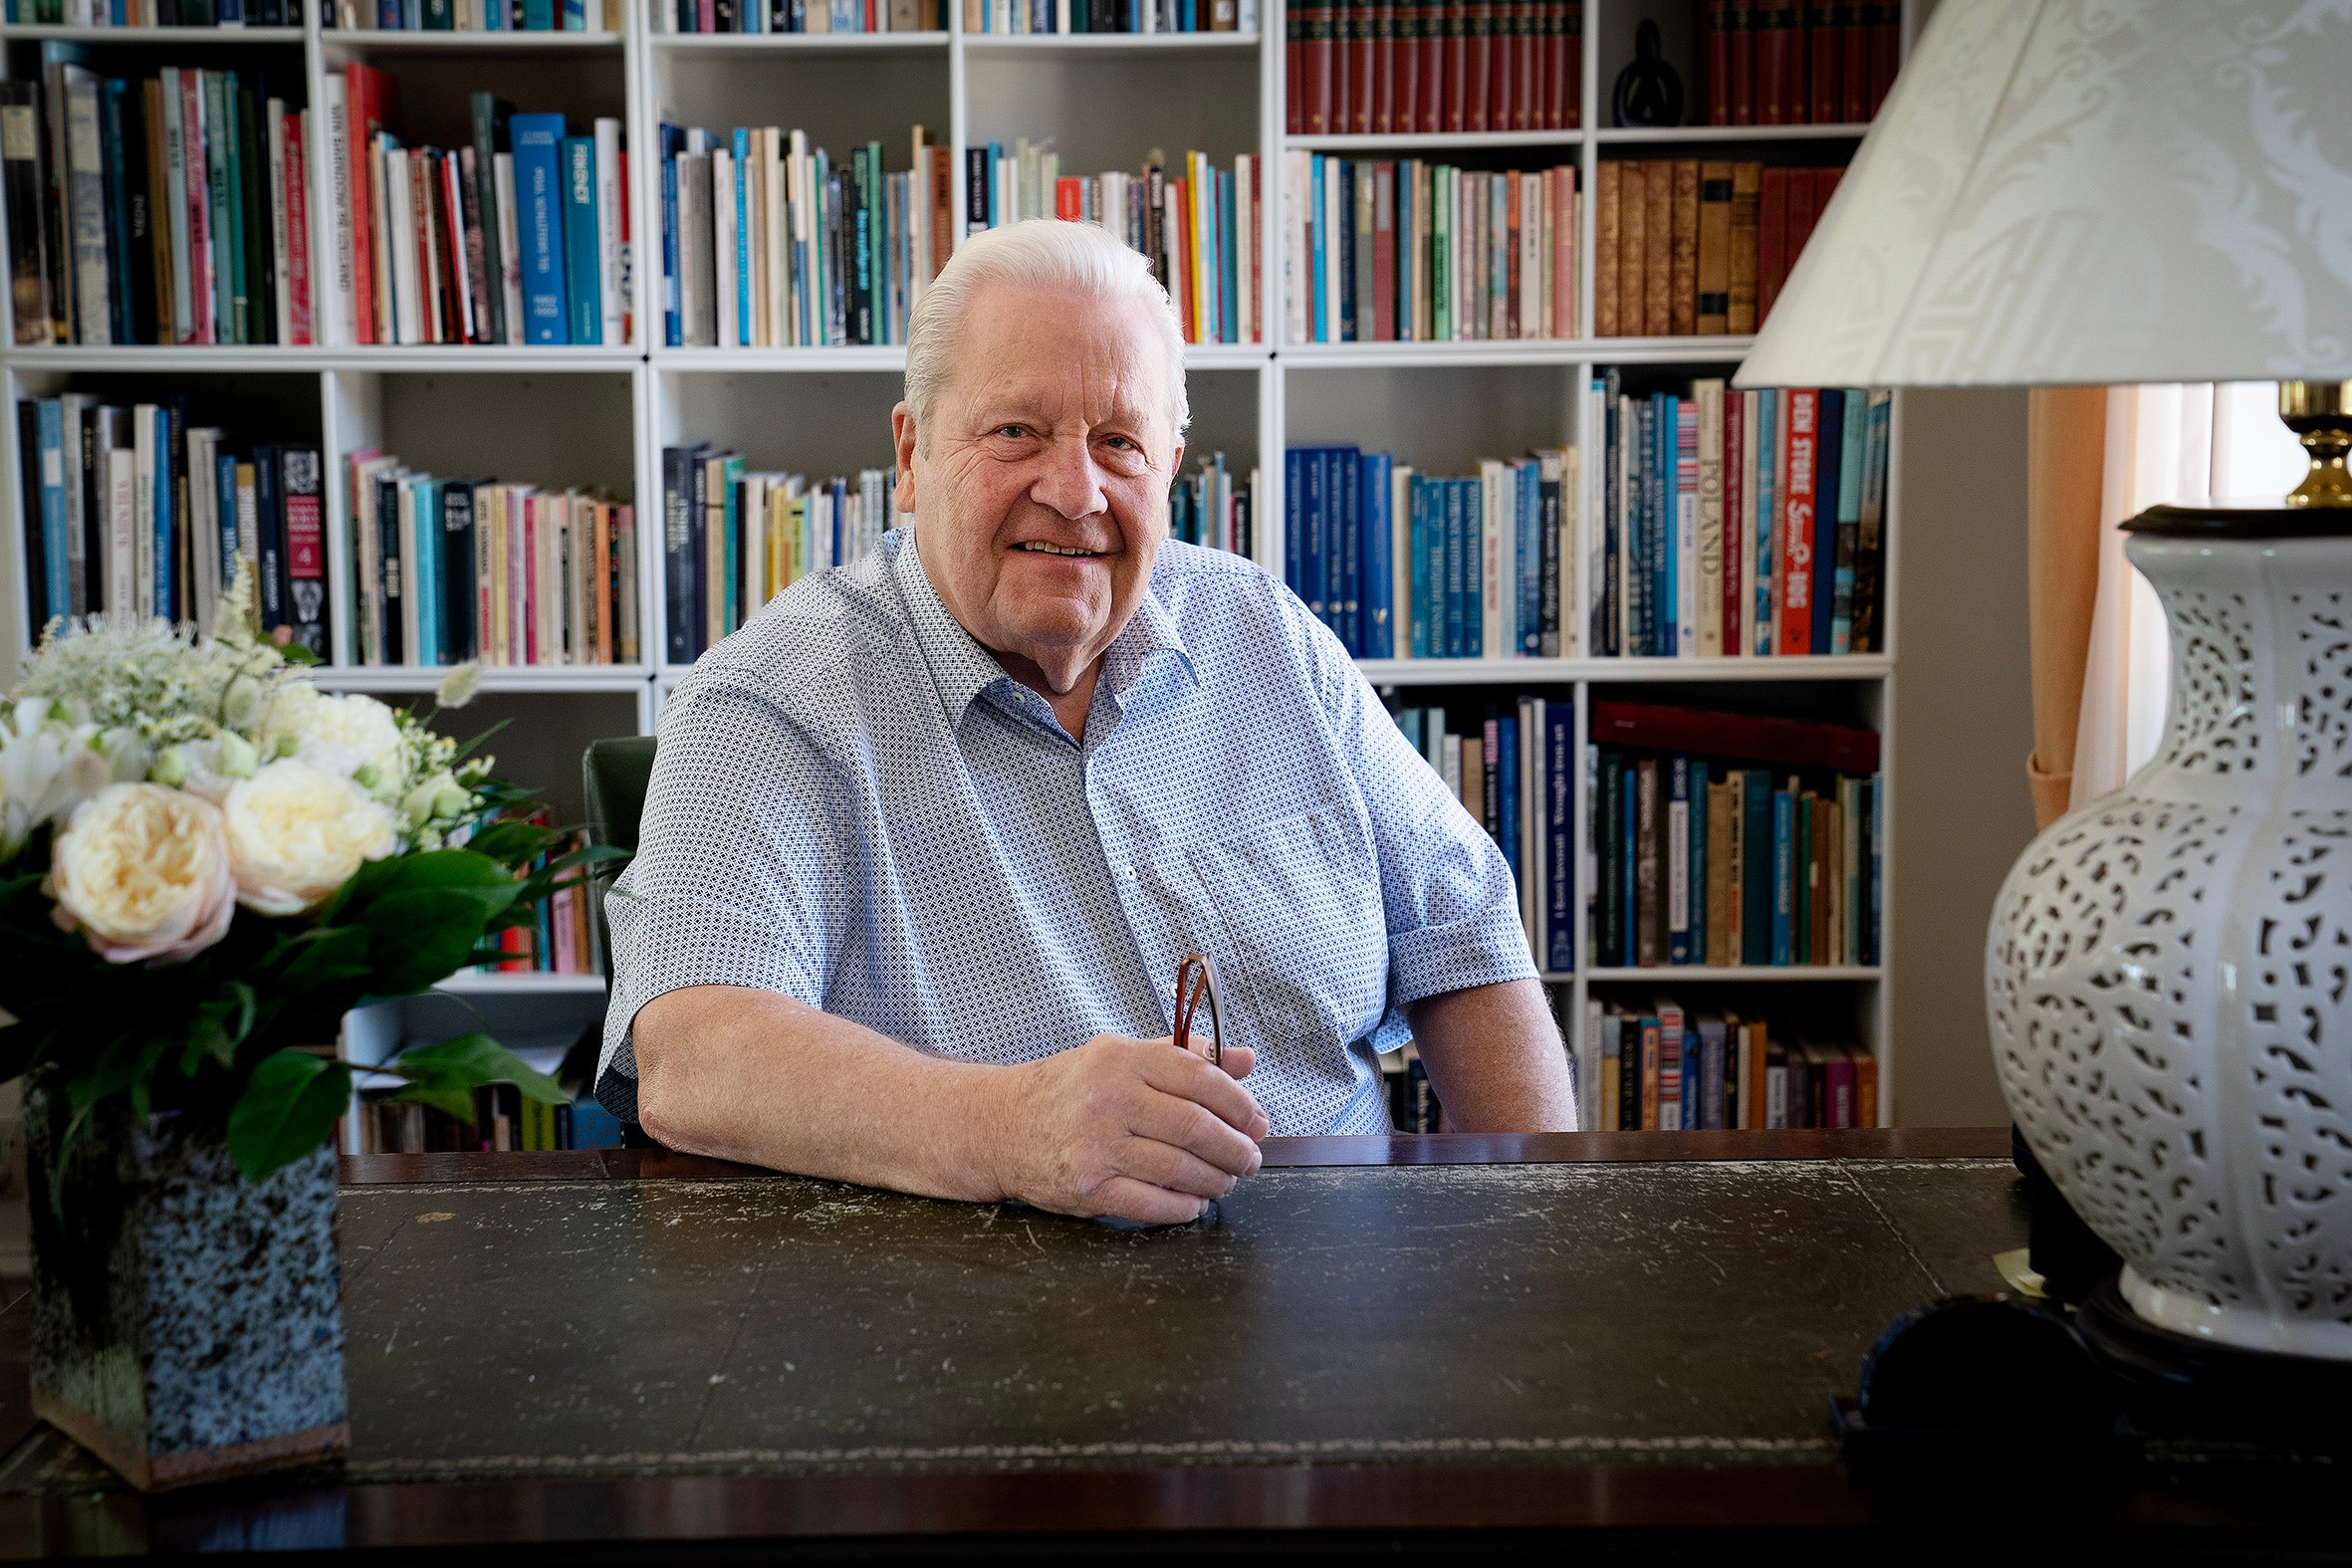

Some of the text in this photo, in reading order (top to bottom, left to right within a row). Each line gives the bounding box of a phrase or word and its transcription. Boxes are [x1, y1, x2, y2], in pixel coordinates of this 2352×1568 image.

[1792, 393, 1813, 434] DEN
[1790, 437, 1812, 496] STORE
[1701, 458, 1722, 576] POLAND
[299, 548, 314, 564] 4
[1551, 744, 1565, 773] iron
[1551, 773, 1568, 825] Wrought
